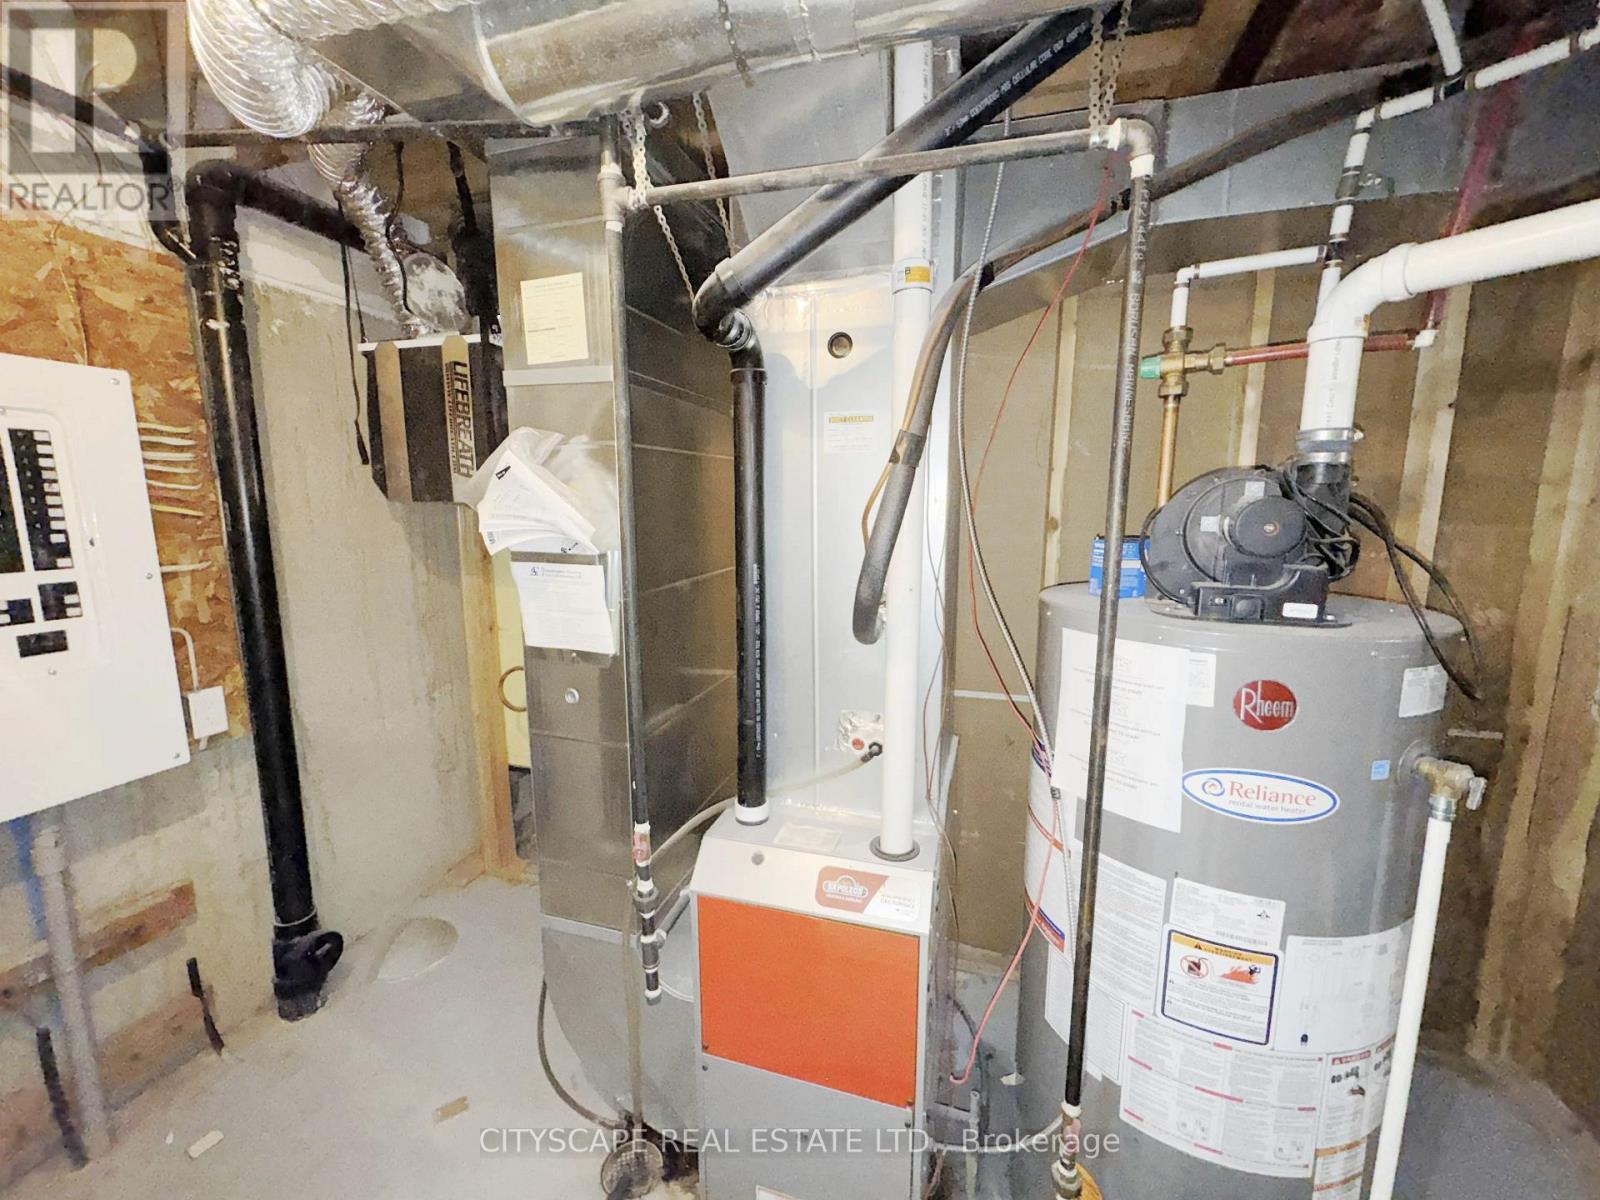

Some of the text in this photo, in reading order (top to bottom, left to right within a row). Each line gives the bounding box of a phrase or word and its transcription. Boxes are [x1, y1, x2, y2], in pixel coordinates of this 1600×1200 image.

[453, 360, 474, 478] LIFEBREATH
[1240, 680, 1293, 723] Rheem
[1229, 780, 1317, 807] Reliance
[1229, 799, 1307, 815] rental water heater
